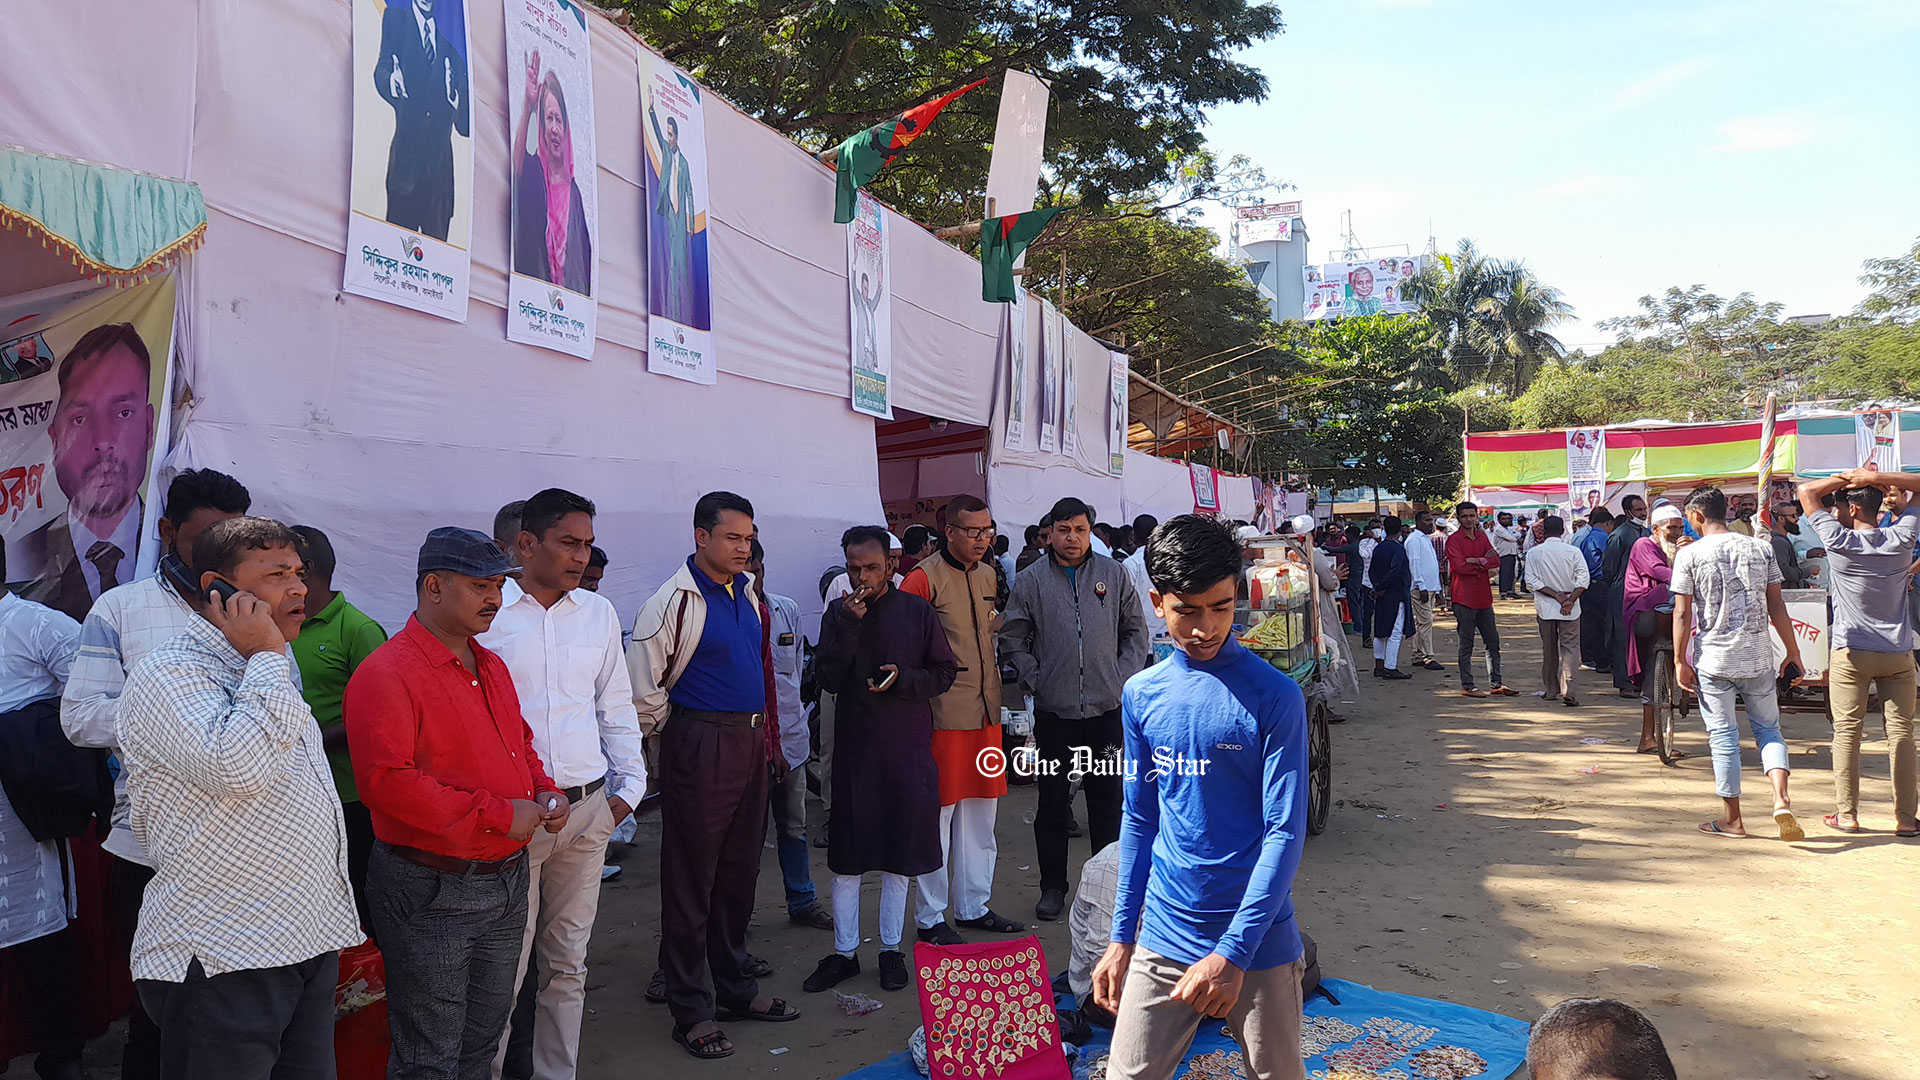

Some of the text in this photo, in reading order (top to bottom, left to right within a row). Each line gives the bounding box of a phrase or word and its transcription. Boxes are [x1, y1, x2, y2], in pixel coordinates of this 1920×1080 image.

[362, 245, 454, 295] সিদ্দিকুর রহমান পাপলু
[1789, 617, 1821, 644] বার
